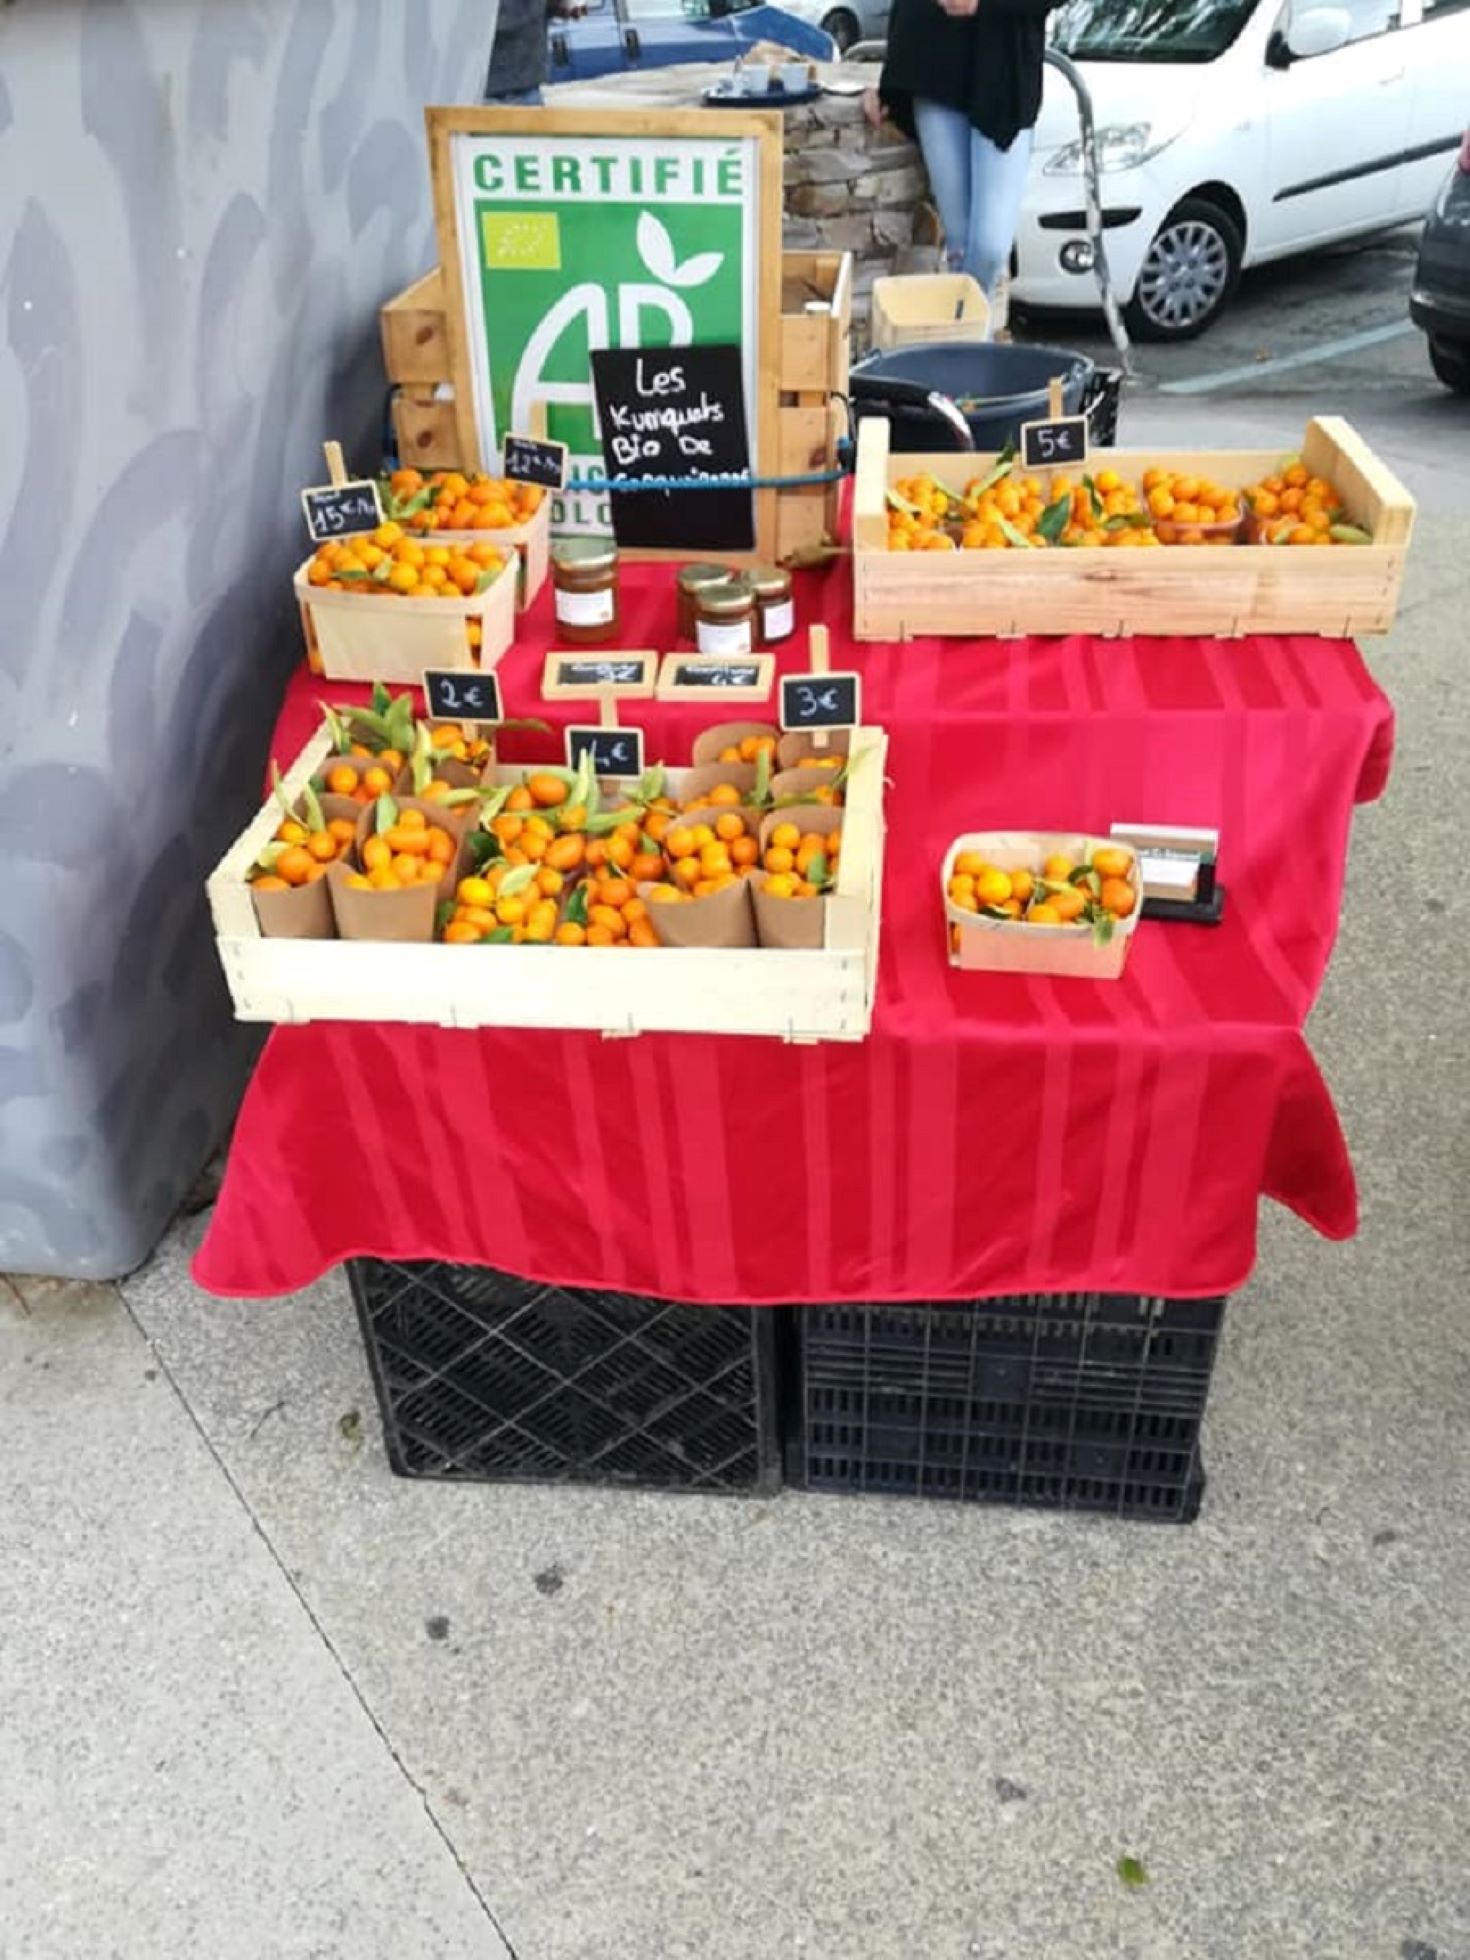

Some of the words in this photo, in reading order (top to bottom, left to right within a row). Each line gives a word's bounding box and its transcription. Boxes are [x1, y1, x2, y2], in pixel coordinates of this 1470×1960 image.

[473, 148, 743, 196] CERTIFIÉ
[636, 358, 687, 397] Les
[611, 433, 661, 465] Bio
[1037, 428, 1072, 457] 5€
[440, 678, 483, 708] 2€
[796, 687, 839, 716] 3€
